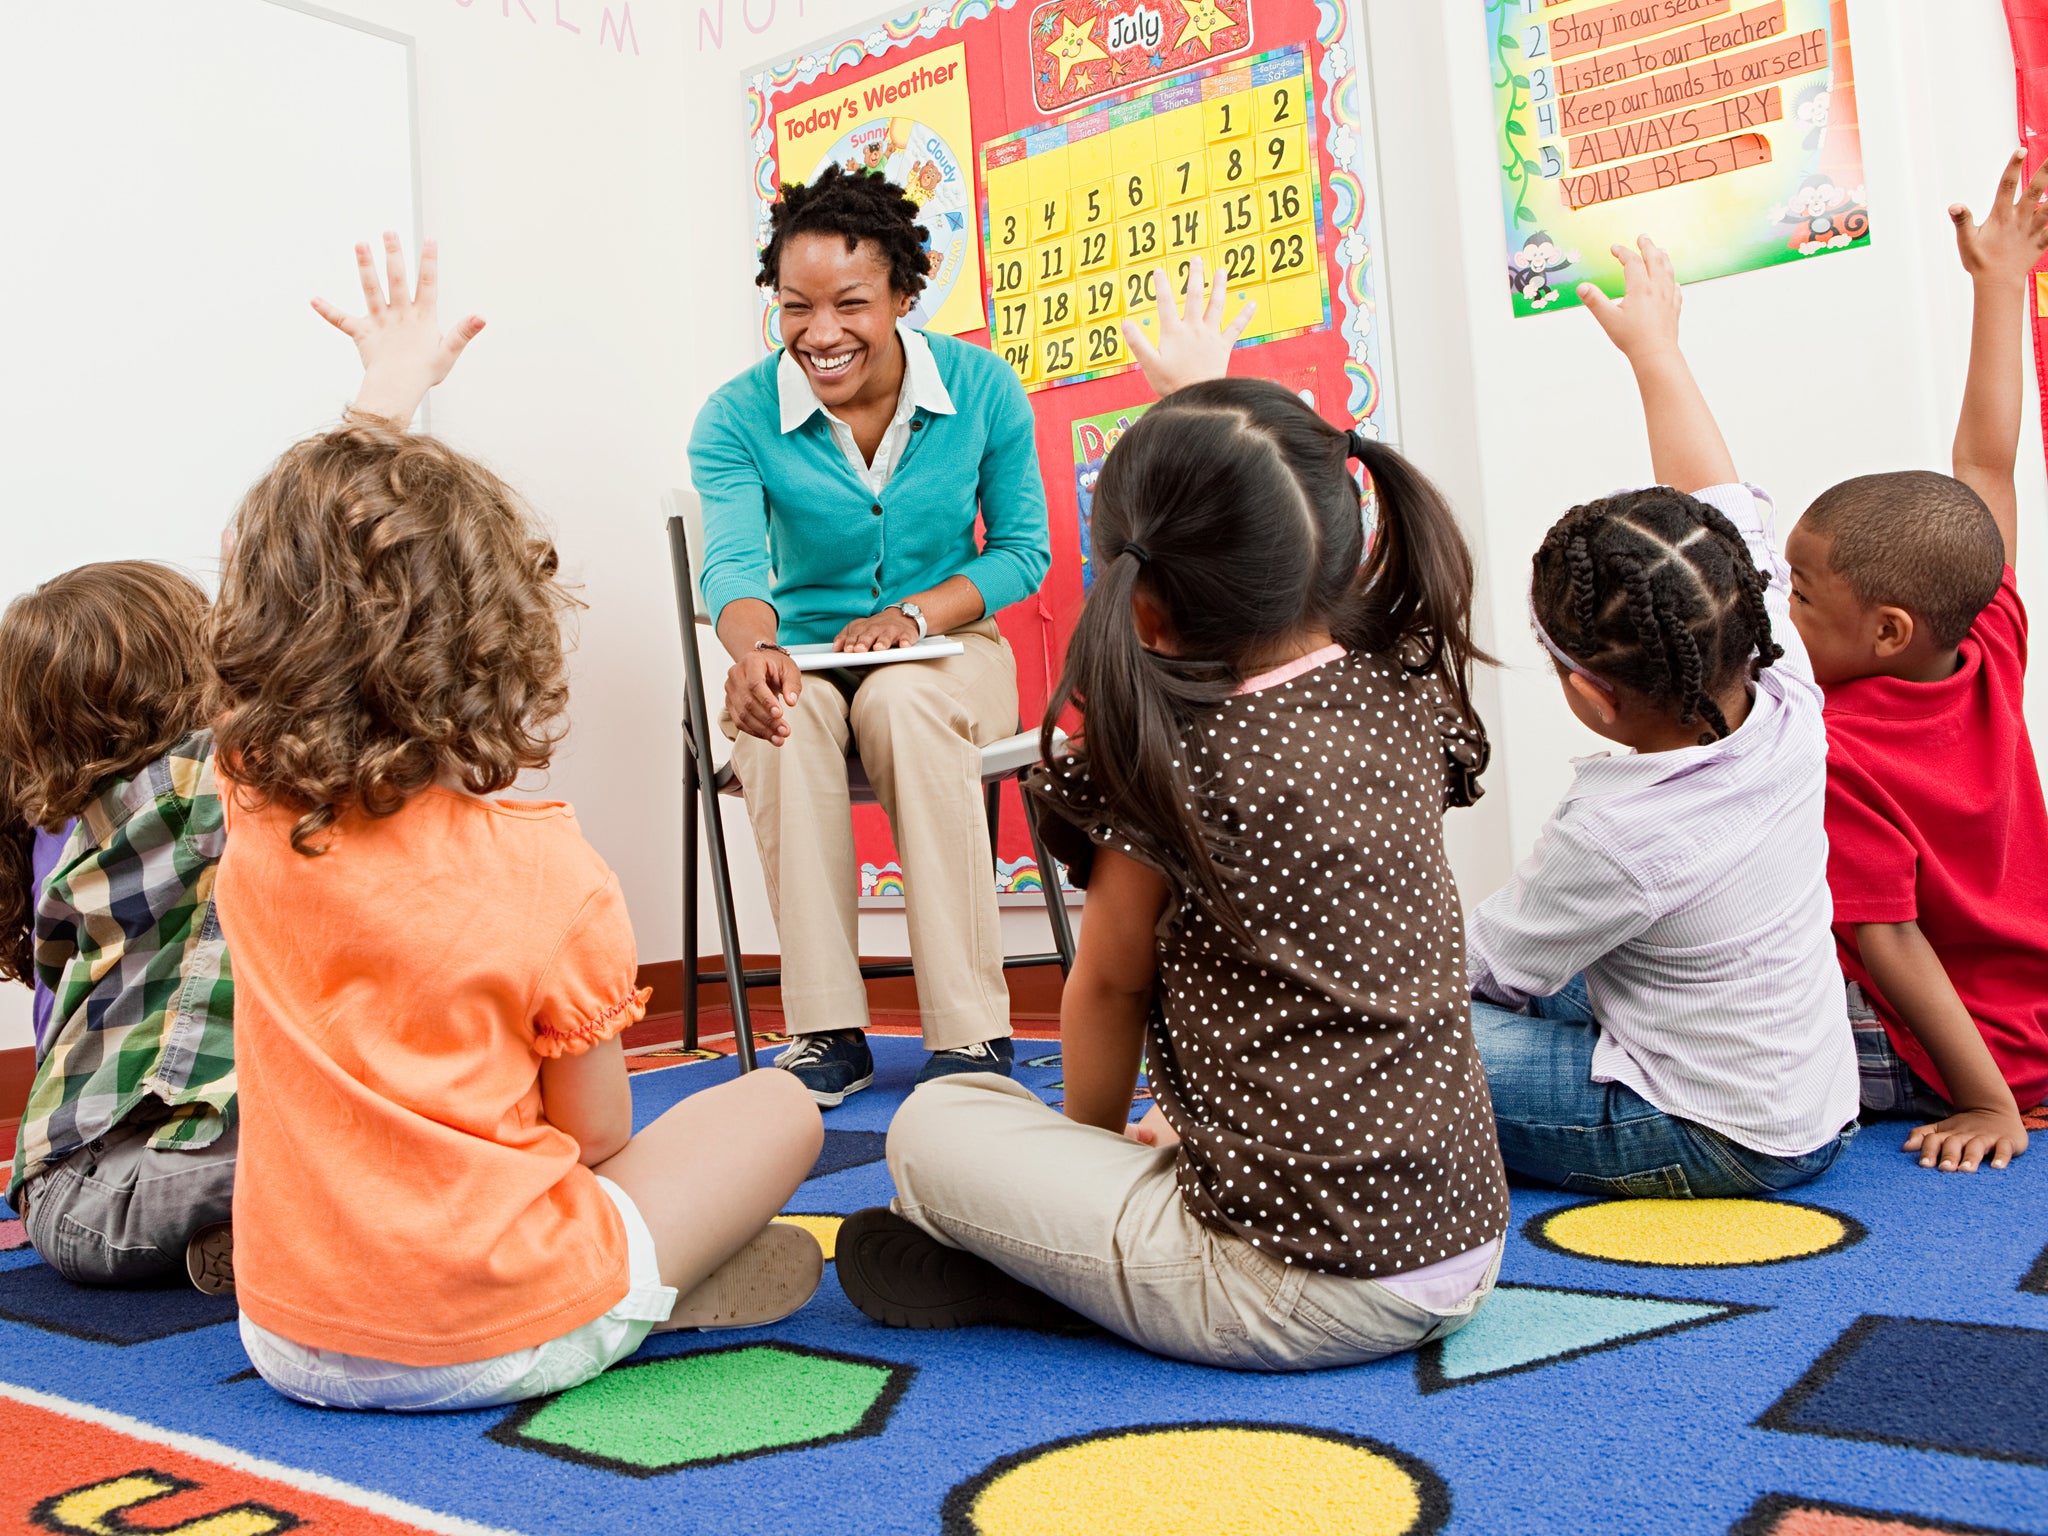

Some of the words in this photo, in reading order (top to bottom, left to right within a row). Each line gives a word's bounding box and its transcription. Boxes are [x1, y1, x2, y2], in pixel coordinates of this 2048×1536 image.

[1112, 13, 1160, 47] July
[1529, 25, 1546, 58] 2
[1553, 13, 1604, 48] Stay
[1159, 86, 1195, 101] Thursday
[1259, 57, 1296, 73] Saturday
[1533, 69, 1549, 102] 3
[1559, 58, 1627, 95] Listen
[1635, 45, 1658, 74] to
[1662, 42, 1692, 65] our
[1700, 13, 1778, 56] teacher
[784, 97, 858, 141] Today's
[863, 61, 959, 112] Weather
[1220, 105, 1231, 133] 1
[1274, 90, 1288, 122] 2
[1538, 104, 1553, 135] 4
[1562, 95, 1616, 128] Keep
[1622, 91, 1650, 114] our
[1652, 66, 1705, 106] hands
[1712, 58, 1734, 89] to
[850, 125, 889, 149] Sunny
[1541, 145, 1560, 177] 5
[1572, 109, 1700, 170] ALWAYS
[1711, 88, 1772, 132] TRY
[926, 138, 956, 184] Cloudy
[1561, 165, 1634, 207] YOUR
[1004, 216, 1015, 244] 3
[1045, 202, 1055, 229] 4
[1088, 190, 1099, 221] 5
[1129, 176, 1142, 206] 6
[1178, 162, 1189, 193] 7
[1228, 150, 1241, 180] 8
[1269, 138, 1284, 169] 9
[997, 261, 1021, 291] 10
[1042, 247, 1062, 279] 11
[1081, 233, 1105, 265] 12
[1129, 222, 1155, 256] 13
[1173, 211, 1198, 246] 14
[1224, 195, 1251, 233] 15
[1269, 186, 1299, 222] 16
[936, 238, 963, 291] Windy
[1003, 304, 1026, 335] 17
[1043, 293, 1067, 324] 18
[1089, 282, 1112, 314] 19
[1225, 245, 1255, 280] 22
[1271, 235, 1303, 273] 23
[1046, 338, 1075, 374] 25
[1090, 326, 1117, 361] 26
